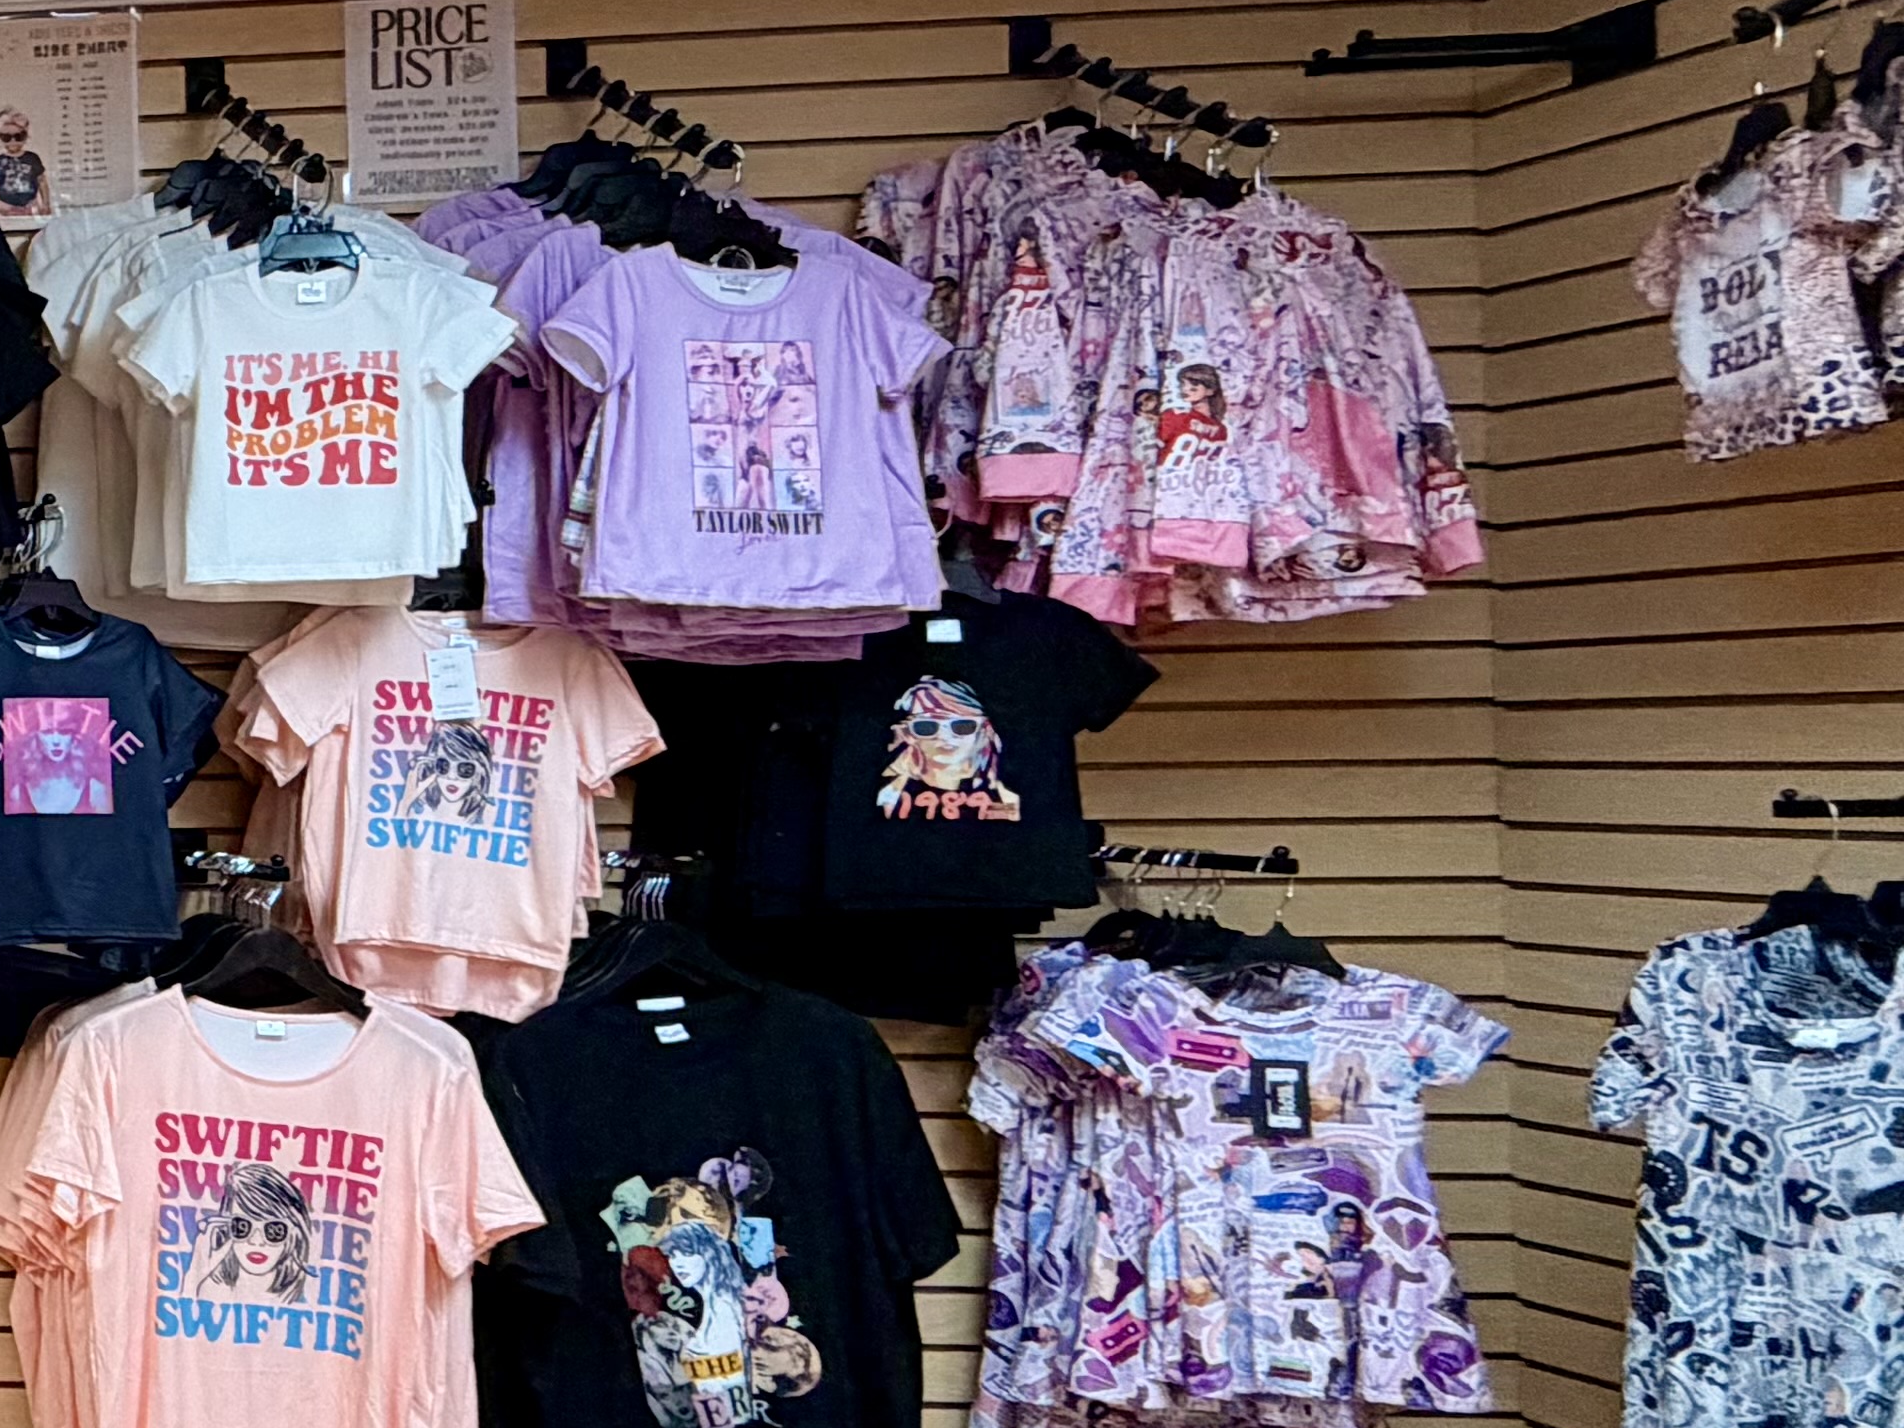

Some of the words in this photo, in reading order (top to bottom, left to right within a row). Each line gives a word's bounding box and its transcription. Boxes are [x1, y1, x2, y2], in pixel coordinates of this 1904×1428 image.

[371, 4, 490, 49] PRICE
[371, 46, 465, 91] LIST
[224, 352, 283, 385] IT'S
[357, 350, 400, 374] HI
[224, 385, 294, 430] I'M
[302, 371, 400, 415] THE
[226, 403, 399, 457] PROBLEM
[227, 451, 310, 486] IT'S
[318, 439, 398, 486] ME
[693, 510, 763, 534] TAYLOR
[767, 512, 824, 536] SWIFT
[373, 679, 555, 731] SWTIE
[898, 790, 993, 821] 1989
[365, 817, 533, 867] SWIFTIE
[155, 1112, 384, 1179] SWIFTIE
[154, 1295, 364, 1361] SWIFTIE
[682, 1353, 743, 1379] THE
